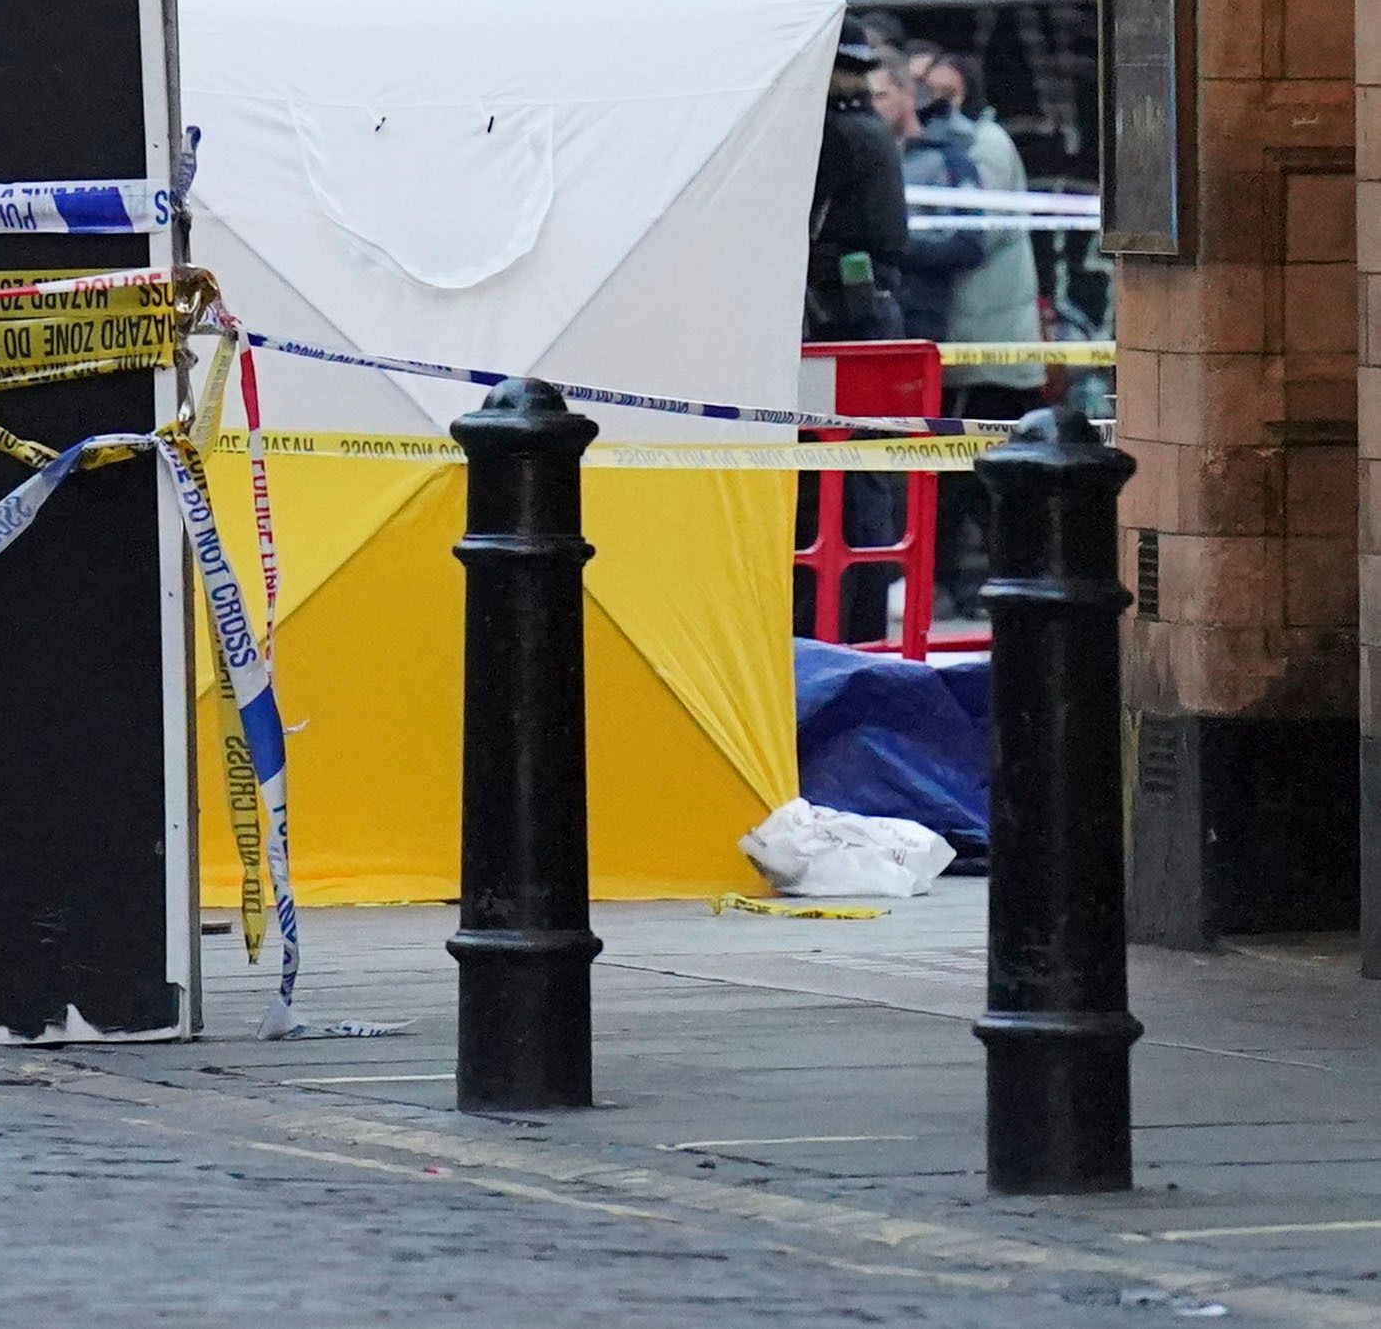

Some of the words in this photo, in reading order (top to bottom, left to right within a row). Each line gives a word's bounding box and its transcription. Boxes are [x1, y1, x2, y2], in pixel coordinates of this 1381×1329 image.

[3, 326, 32, 361] DO
[44, 324, 95, 357] ZONE
[101, 313, 176, 351] HAZARD
[181, 491, 211, 524] DO
[193, 527, 230, 576] NOT
[210, 582, 258, 670] CROSS
